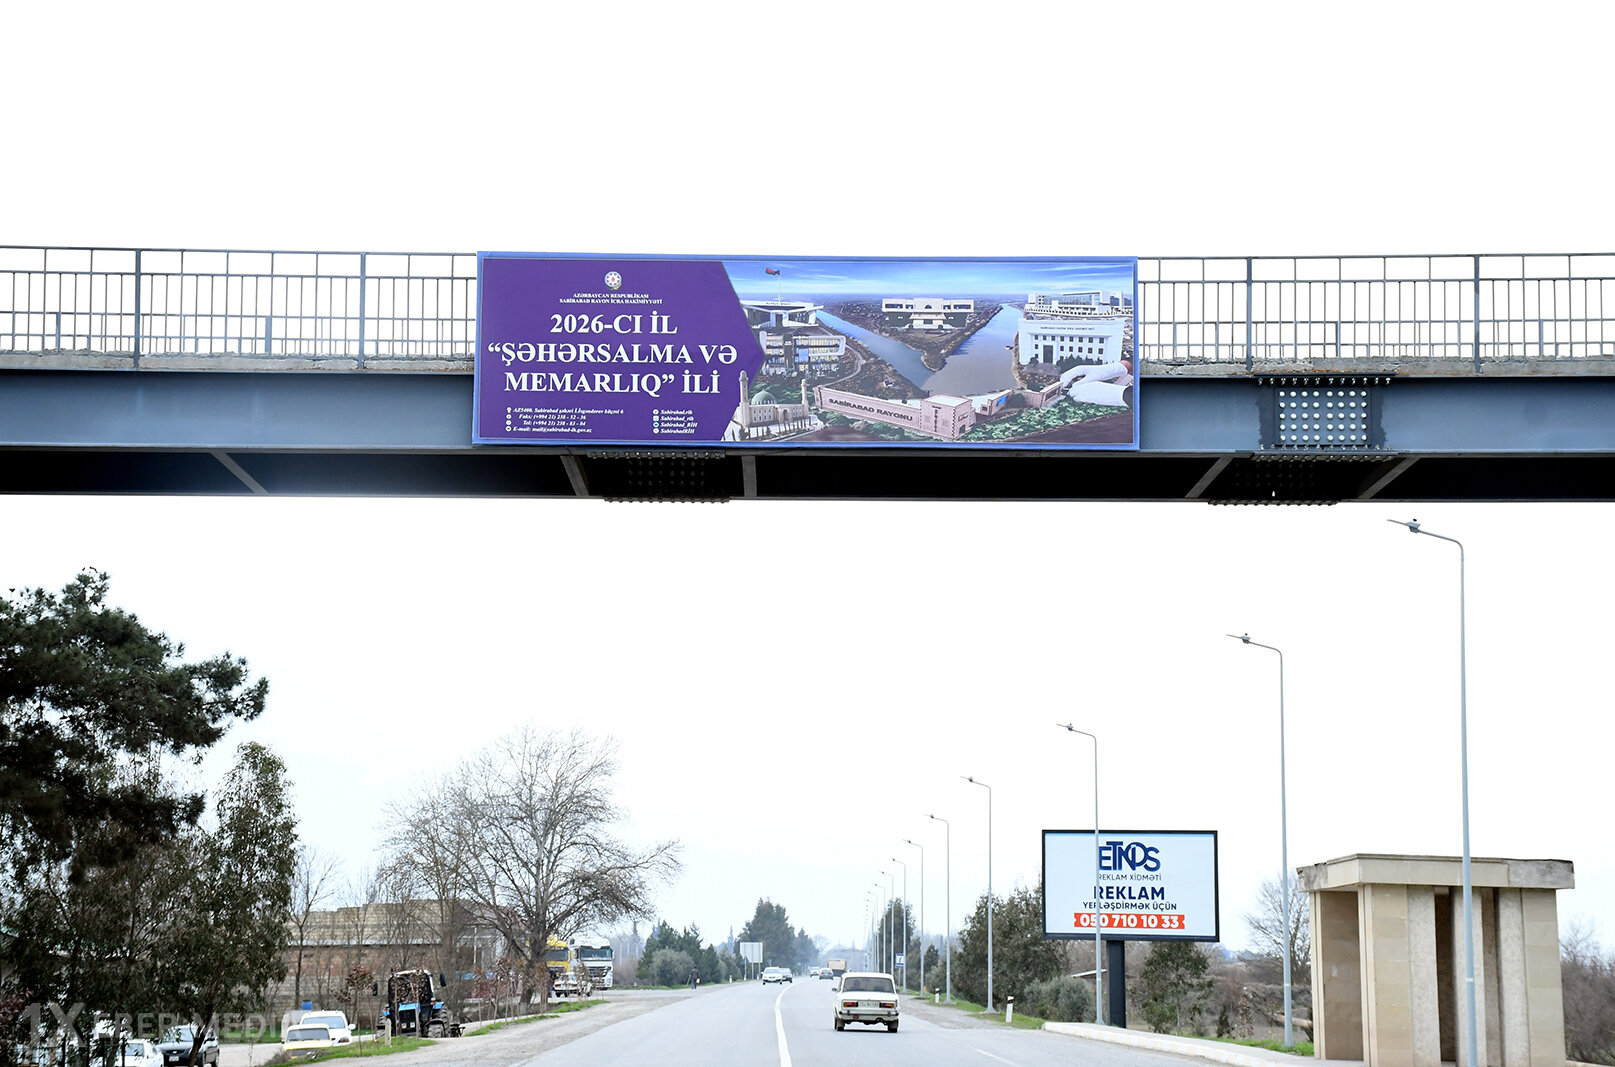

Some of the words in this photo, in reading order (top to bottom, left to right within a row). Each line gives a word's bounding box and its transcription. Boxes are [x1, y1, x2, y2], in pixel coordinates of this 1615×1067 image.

[550, 314, 643, 334] 2026-CI
[652, 310, 678, 334] İL
[488, 342, 693, 366] “ŞƏHƏRSALMA
[698, 344, 738, 365] VƏ
[504, 372, 675, 398] MEMARLIQ”
[682, 369, 720, 394] İLİ
[828, 398, 875, 413] SABİRABAD
[876, 408, 913, 421] RAYONU
[1129, 873, 1162, 881] XİDMƏTİ
[1093, 885, 1165, 900] REKLAM
[1152, 901, 1177, 912] ÜÇÜN
[1080, 913, 1109, 927] 050
[1112, 914, 1138, 928] 710
[1141, 915, 1158, 928] 10
[1161, 915, 1179, 928] 33
